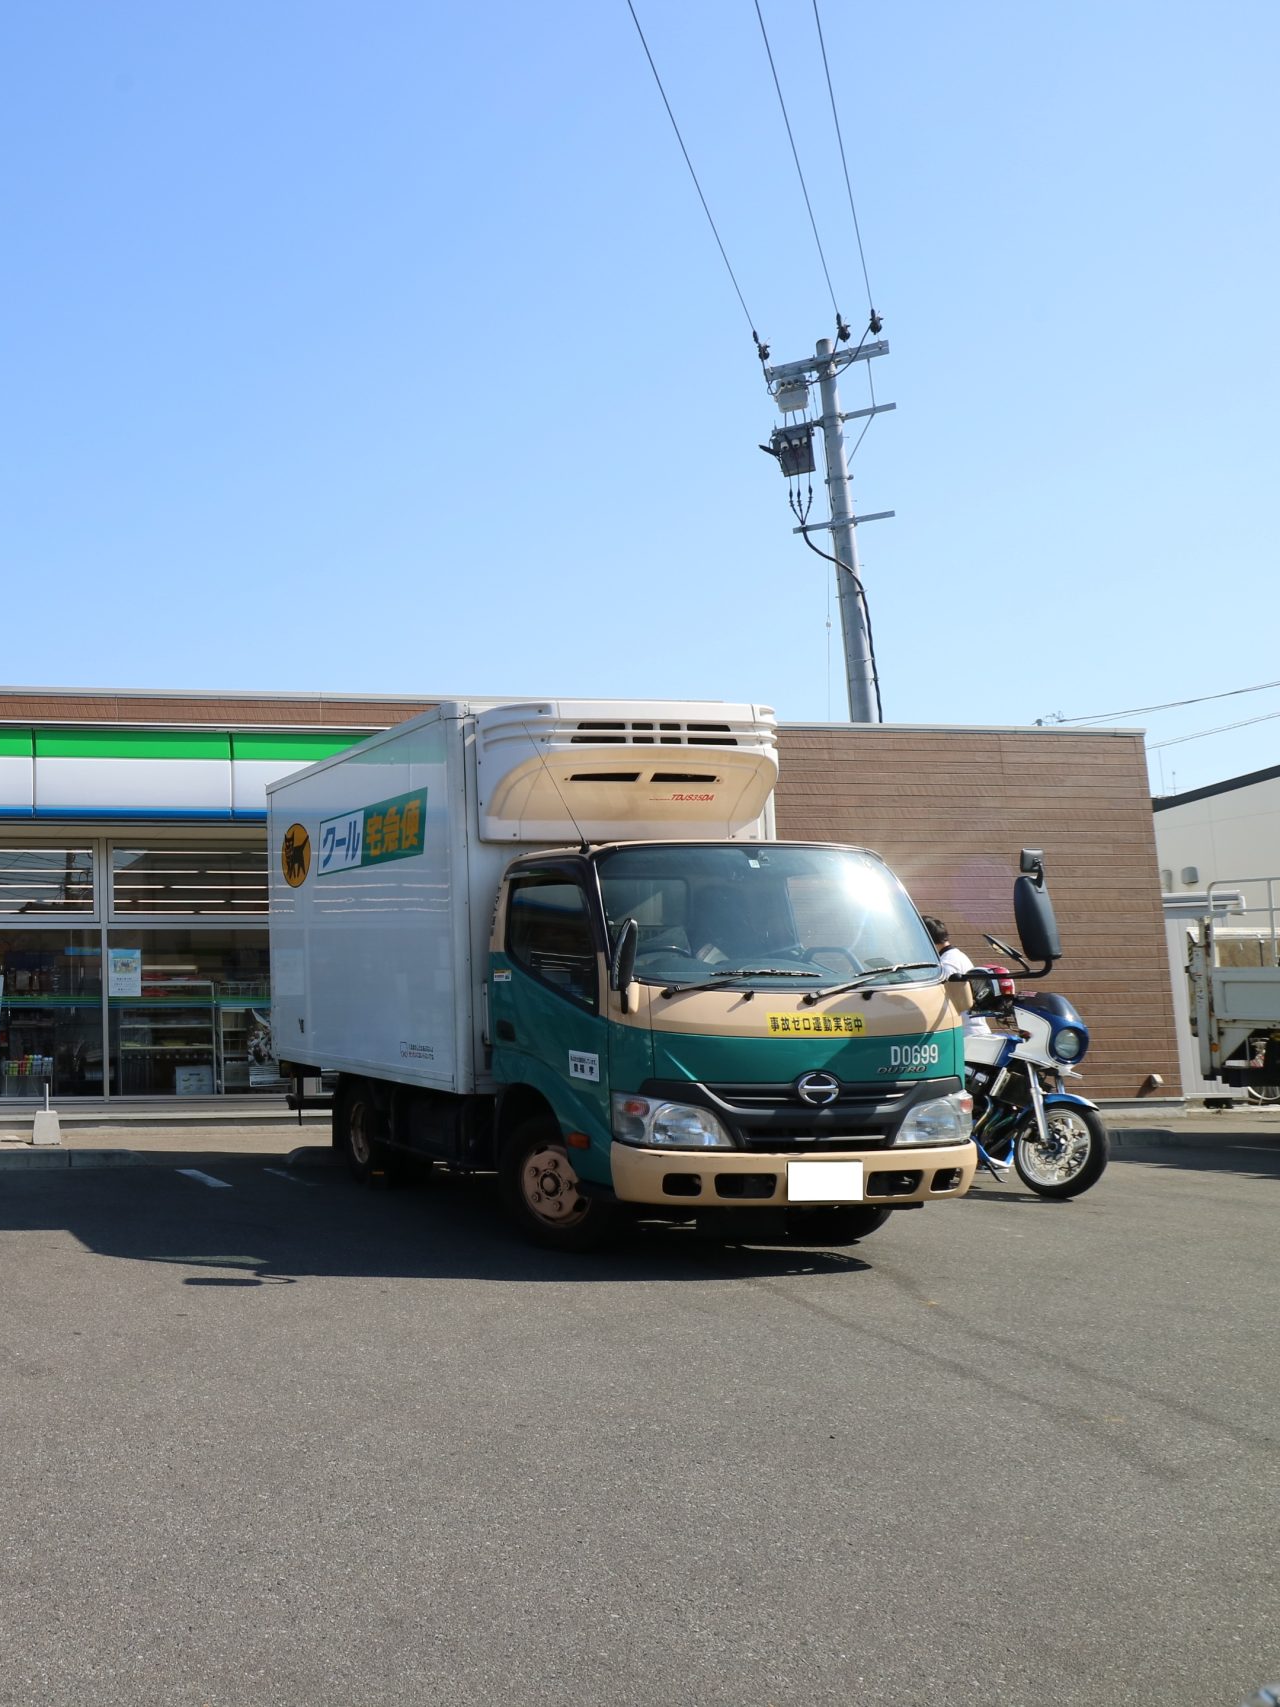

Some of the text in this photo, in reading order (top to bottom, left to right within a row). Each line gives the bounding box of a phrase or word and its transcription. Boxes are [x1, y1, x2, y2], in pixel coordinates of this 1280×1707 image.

[770, 1016, 863, 1033] 事故ゼロ運動実施中
[890, 1044, 939, 1066] D0699
[877, 1065, 928, 1074] DUTRO
